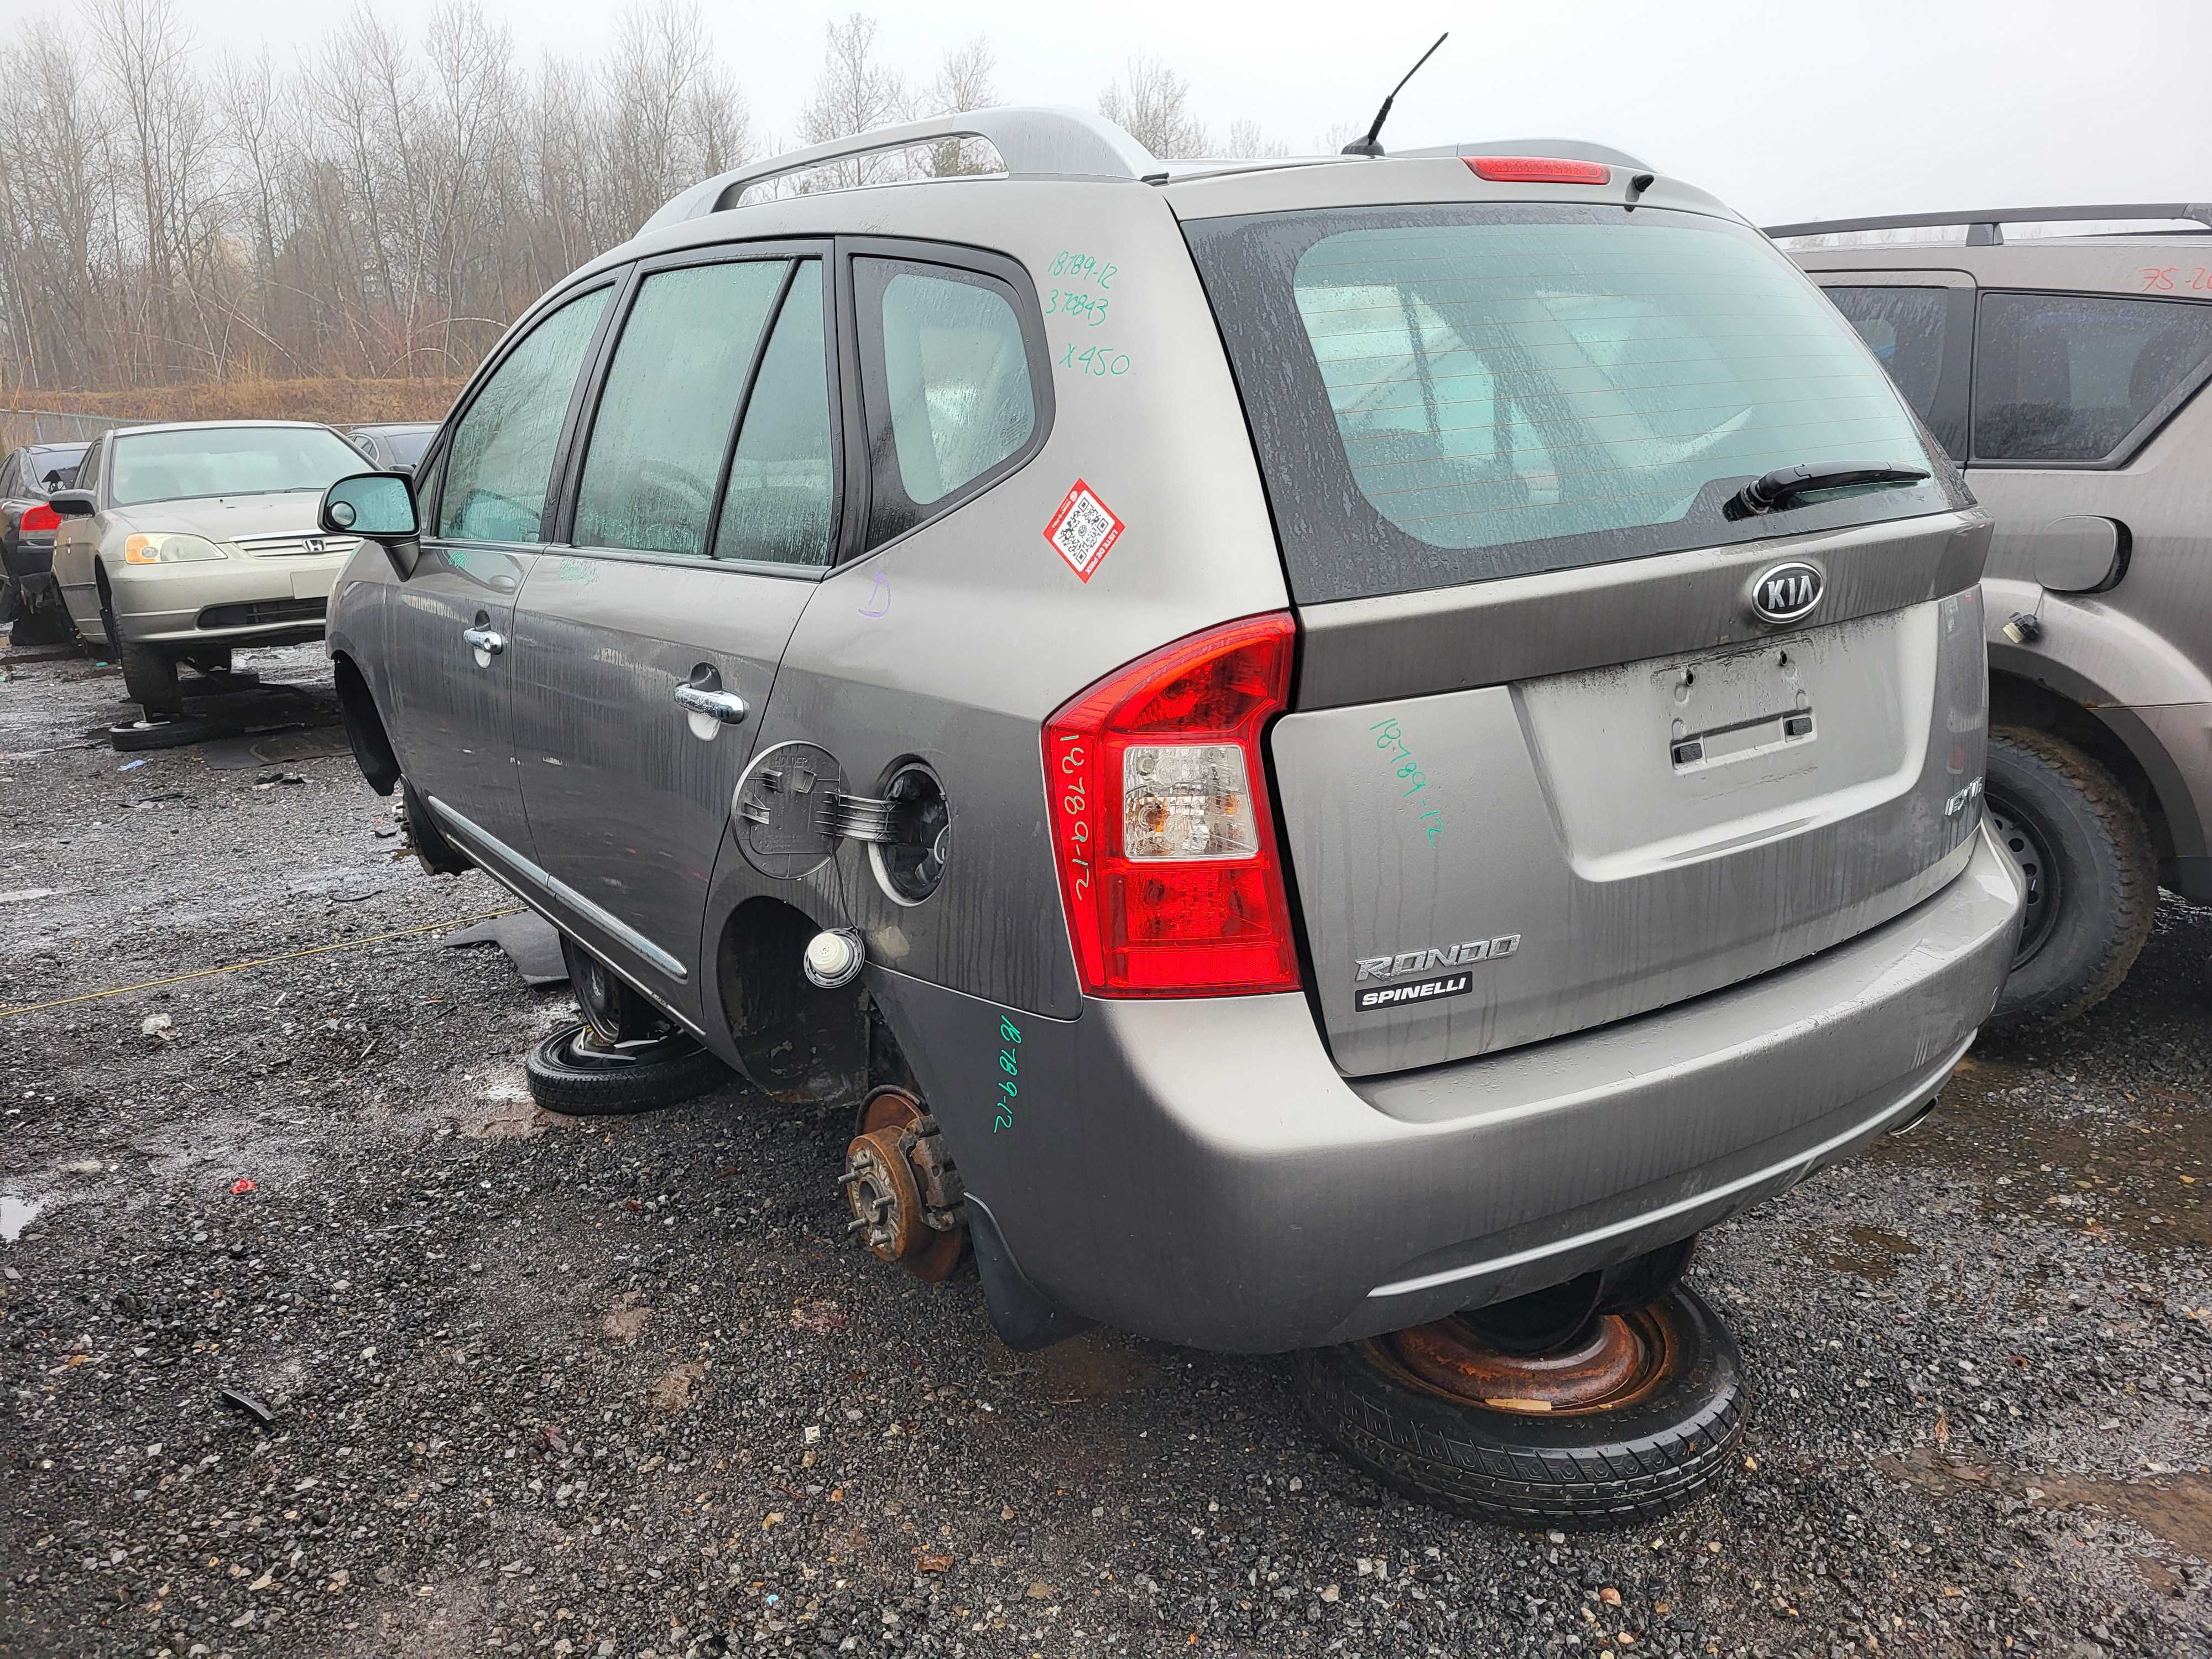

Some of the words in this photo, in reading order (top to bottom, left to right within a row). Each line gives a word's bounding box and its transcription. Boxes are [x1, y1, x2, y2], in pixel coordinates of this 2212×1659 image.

[1058, 343, 1130, 376] X450
[1095, 547, 1106, 560] DE
[1103, 528, 1118, 550] LISTE
[1085, 557, 1098, 575] PRIX
[1767, 575, 1813, 609] KIA
[1369, 718, 1443, 848] 18789-12
[1060, 735, 1088, 900] 18789-12
[1355, 934, 1521, 982] RONDO
[1361, 977, 1467, 1006] SPINELLI
[994, 1015, 1022, 1133] 18789-12
